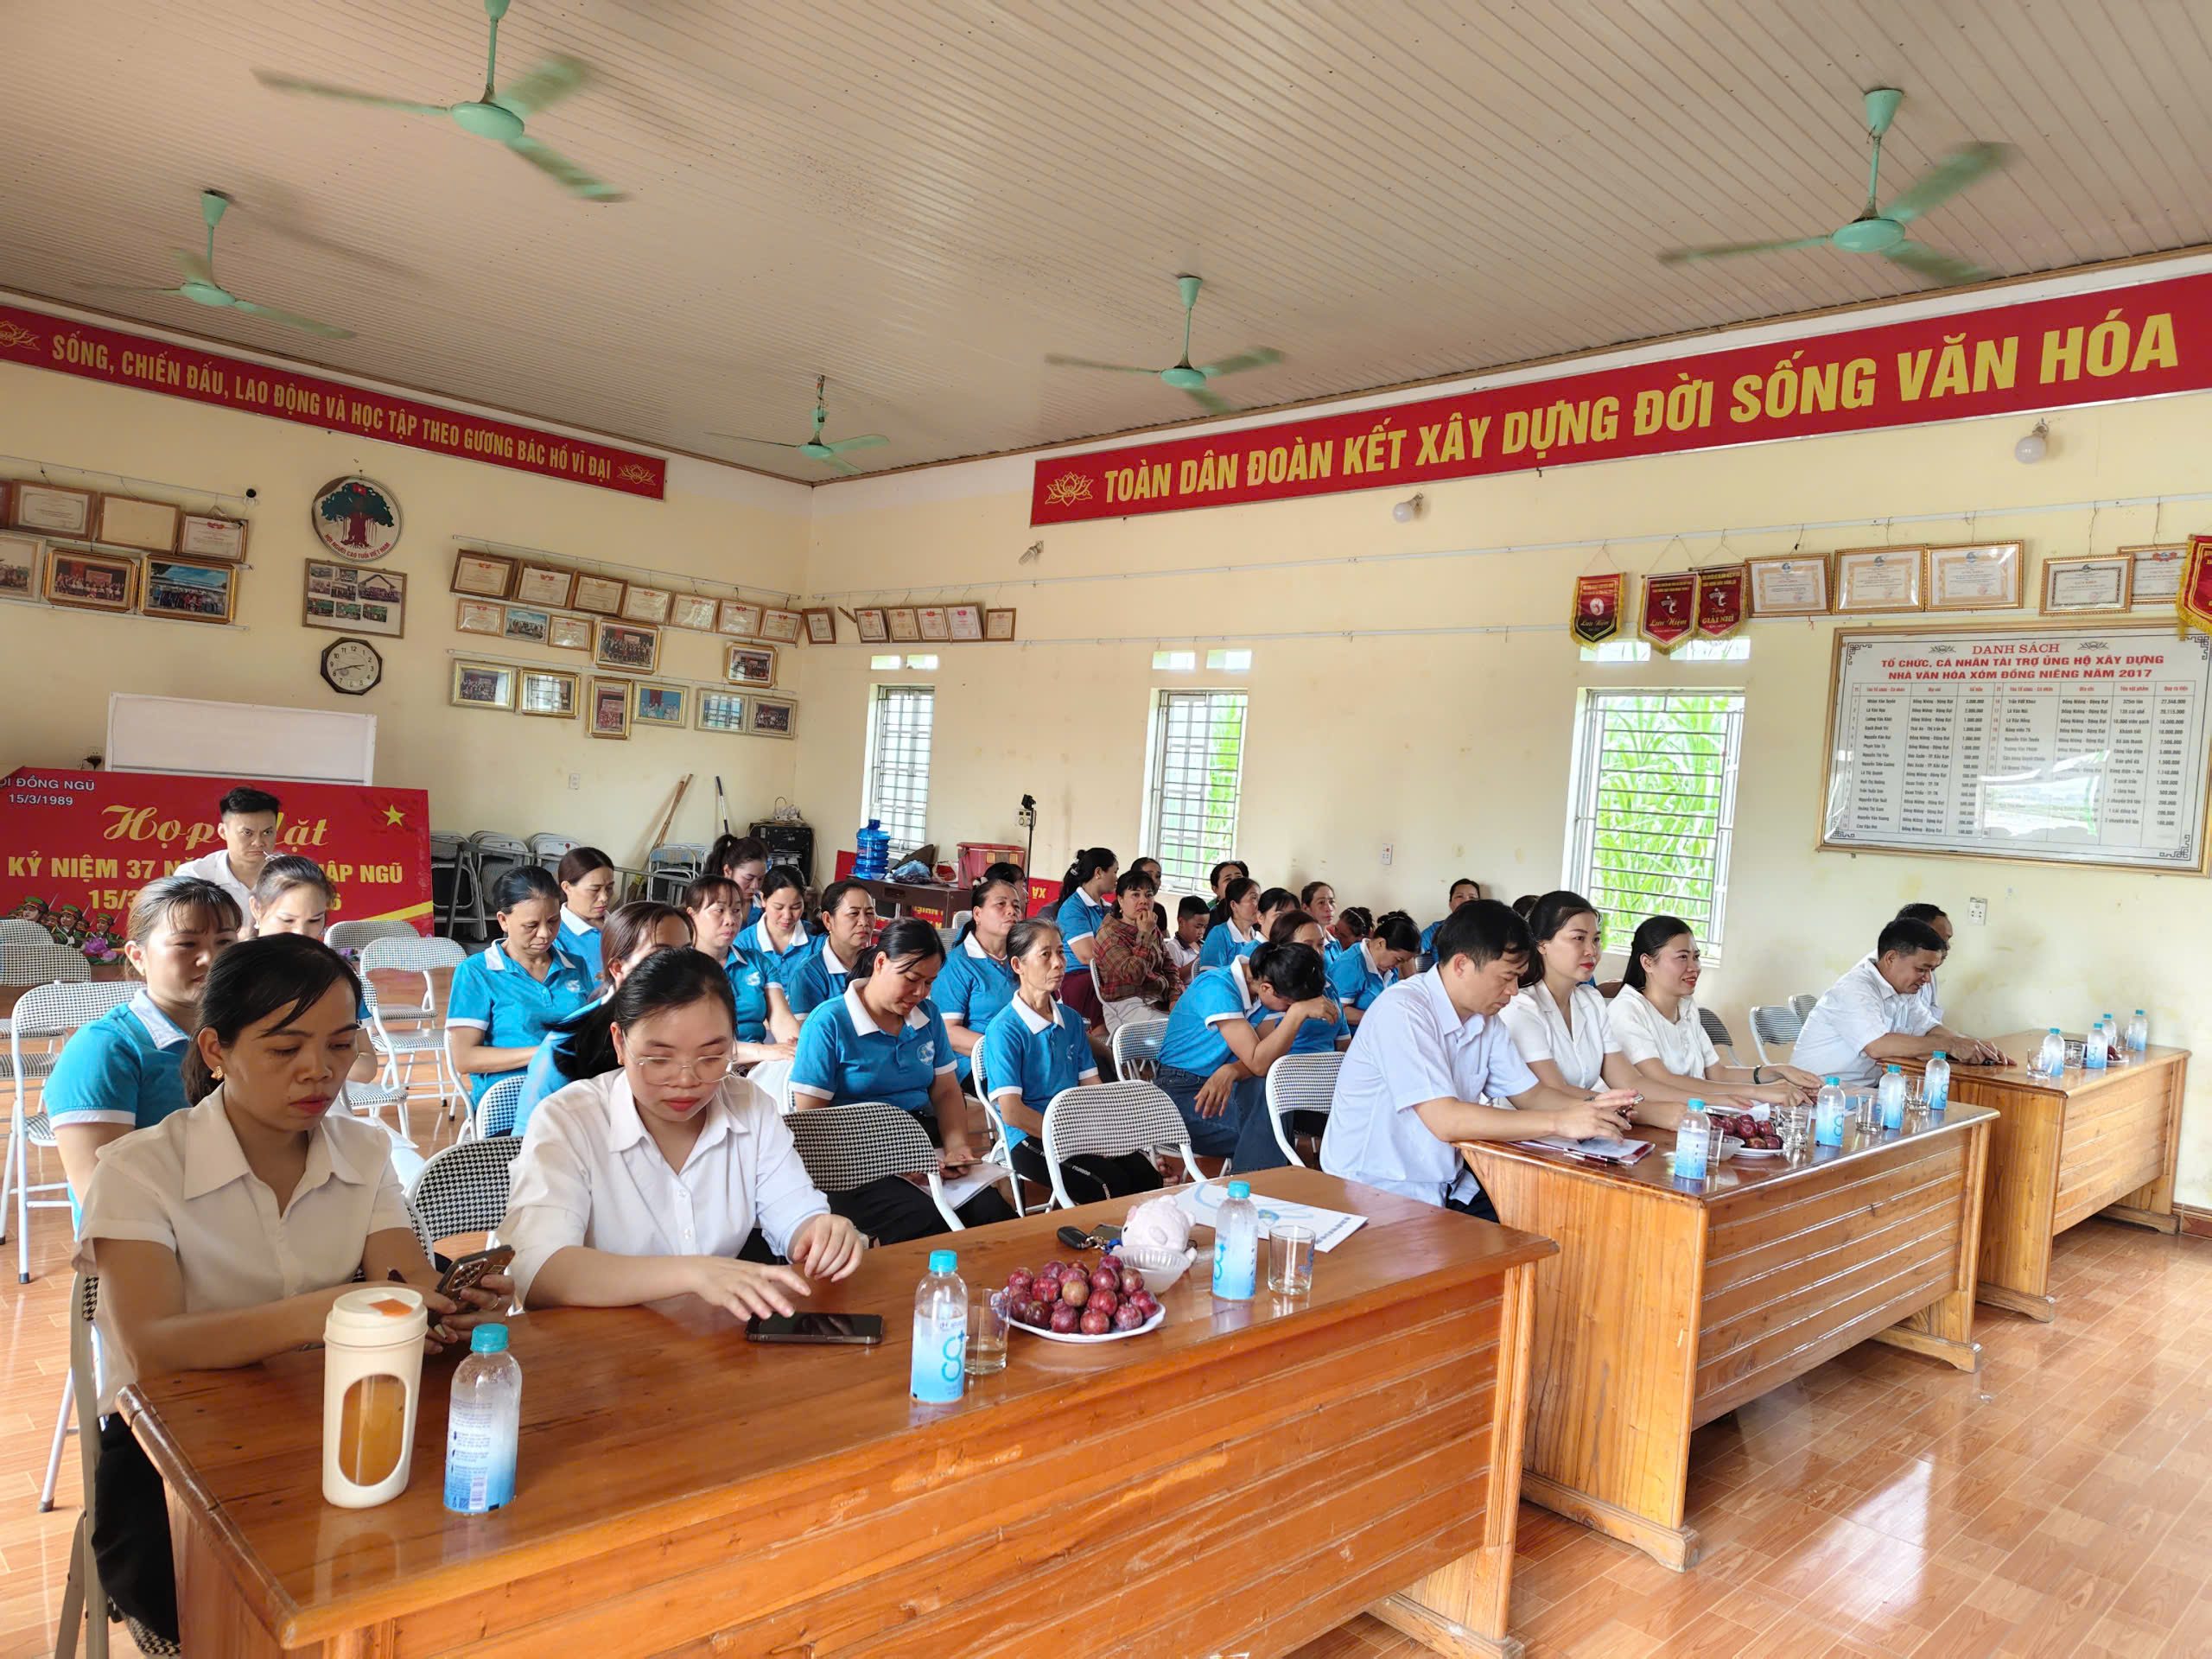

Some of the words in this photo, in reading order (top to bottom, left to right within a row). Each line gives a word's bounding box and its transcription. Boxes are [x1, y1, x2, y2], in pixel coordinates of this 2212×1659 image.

[53, 331, 115, 373] SỐNG,
[122, 351, 180, 385] CHIẾN
[187, 362, 229, 398] ĐẤU,
[235, 376, 268, 404] LAO
[273, 383, 321, 416] ĐỘNG
[326, 393, 346, 421] VÀ
[351, 403, 383, 431] HỌC
[389, 409, 417, 439] TẬP
[423, 418, 459, 447] THEO
[464, 429, 513, 459] GƯƠNG
[518, 439, 545, 466] BÁC
[550, 446, 568, 469] HỒ
[572, 449, 584, 474] VĨ
[588, 456, 610, 480] ĐẠI
[1105, 459, 1172, 503] TOÀN
[1179, 449, 1238, 494] DÂN
[1247, 436, 1333, 486] ĐOÀN
[1343, 417, 1407, 475] KẾT
[1415, 412, 1491, 466] XÂY
[1502, 397, 1619, 459] DỰNG
[1633, 372, 1714, 435] ĐỜI
[1730, 350, 1877, 423] SỐNG
[1897, 333, 2018, 401] VĂN
[2039, 308, 2178, 385] HÓA
[1972, 645, 2015, 654] DANH
[2018, 641, 2060, 653] SÁCH
[1881, 658, 1897, 668] TỔ
[1936, 658, 1952, 667] CÁ
[1955, 658, 1989, 667] NHÂN
[1993, 657, 2012, 666] TÀI
[2016, 657, 2040, 666] TRỢ
[2043, 655, 2069, 665] ỦNG
[2074, 655, 2092, 666] HỘ
[2095, 655, 2122, 664] XÂY
[2126, 655, 2164, 666] DỰNG
[1888, 670, 1912, 679] NHÀ
[1916, 670, 1939, 679] VĂN
[1942, 670, 1966, 679] HÓA
[1970, 670, 1997, 679] XÓM
[2000, 669, 2035, 678] ĐỒNG
[2039, 668, 2079, 678] NIÊNG
[2083, 668, 2114, 677] NĂM
[2119, 669, 2152, 677] 2017
[16, 774, 59, 789] ĐỒNG
[64, 779, 95, 791] NGŨ
[9, 793, 74, 806] 15/3/1989
[101, 804, 220, 851] Họp
[276, 811, 329, 853] ặt
[8, 850, 42, 878] KỶ
[51, 854, 118, 883] NIỆM
[126, 860, 156, 880] 37
[359, 862, 403, 884] NGŨ
